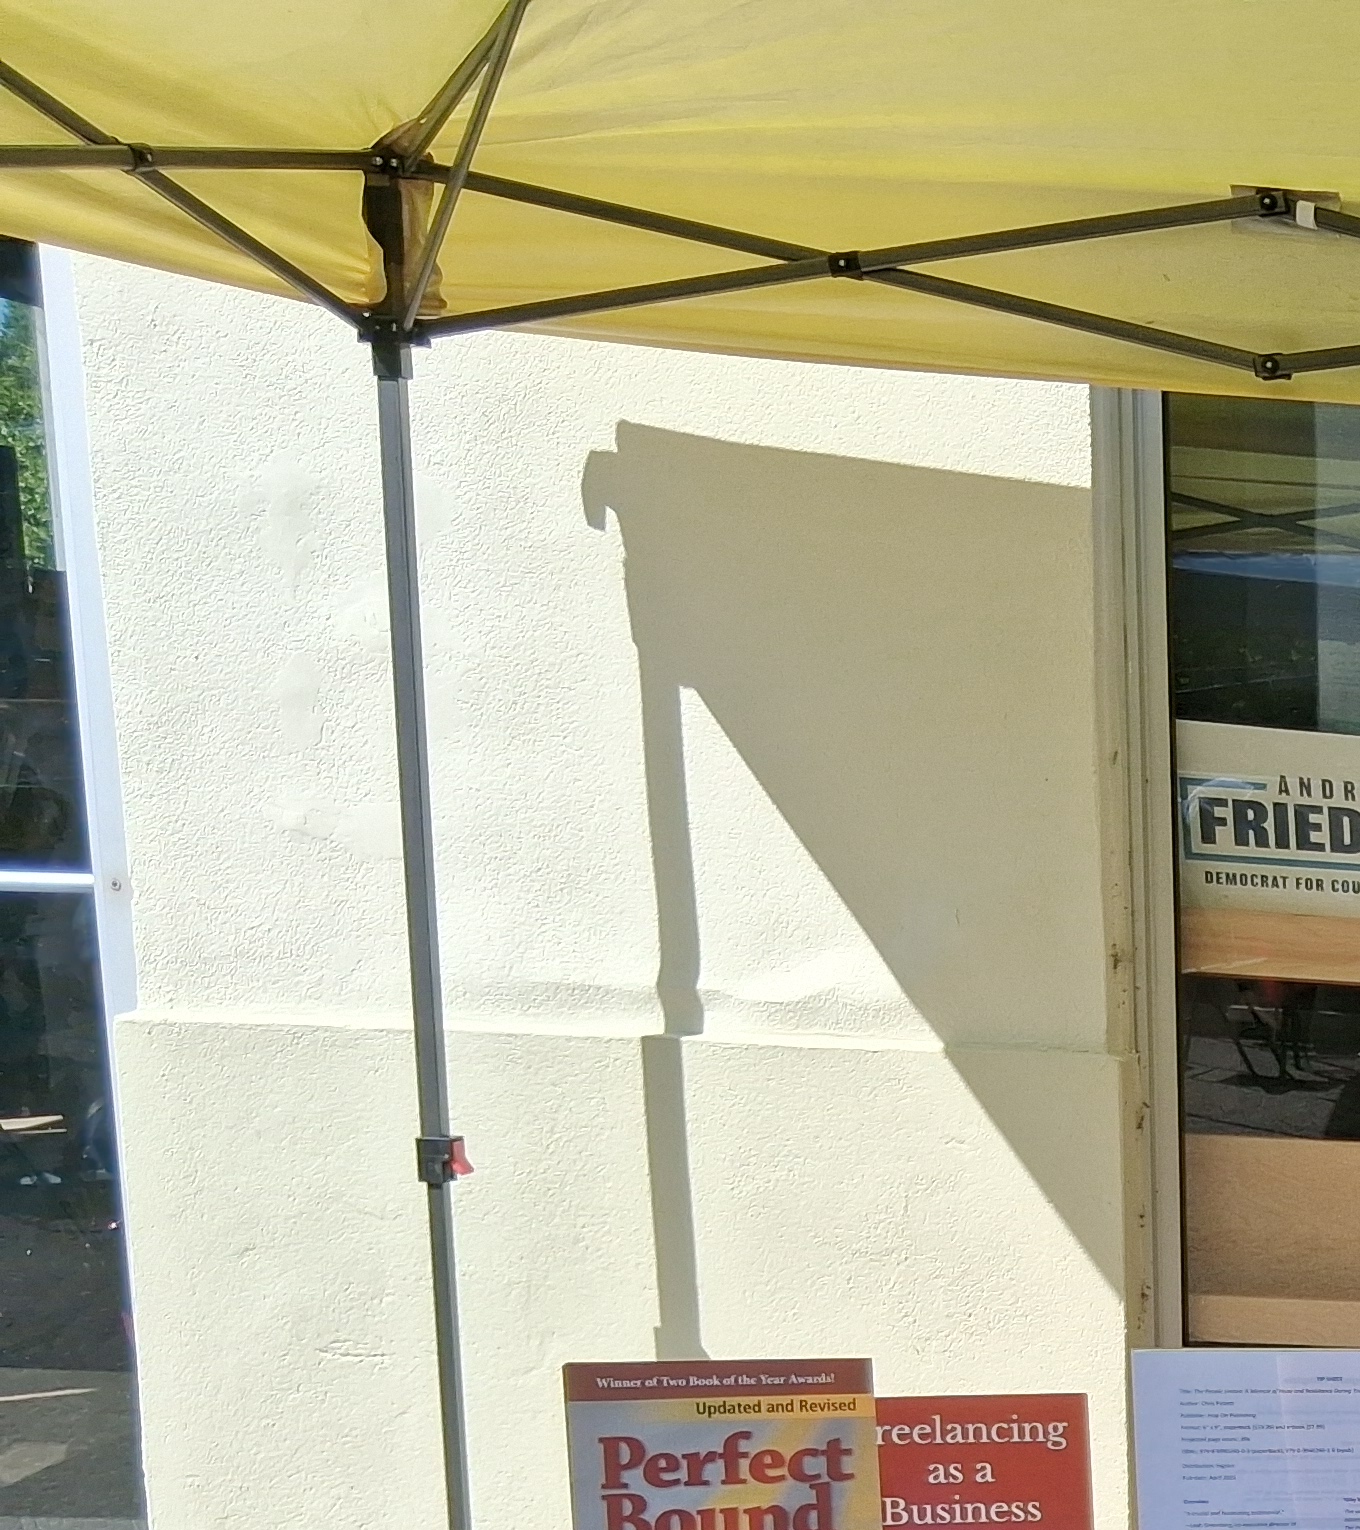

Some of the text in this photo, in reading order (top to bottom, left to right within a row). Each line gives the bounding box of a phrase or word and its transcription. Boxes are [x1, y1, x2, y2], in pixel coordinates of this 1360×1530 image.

[1205, 870, 1289, 890] DEMOCRAT
[1295, 877, 1324, 892] FOR
[596, 1372, 835, 1388] Winner of Two Book of the Year Awards!
[695, 1398, 857, 1418] Updated and Revised
[876, 1416, 1068, 1450] reelancing
[597, 1430, 855, 1490] Perfect
[928, 1462, 996, 1485] as a
[882, 1495, 1042, 1526] Business
